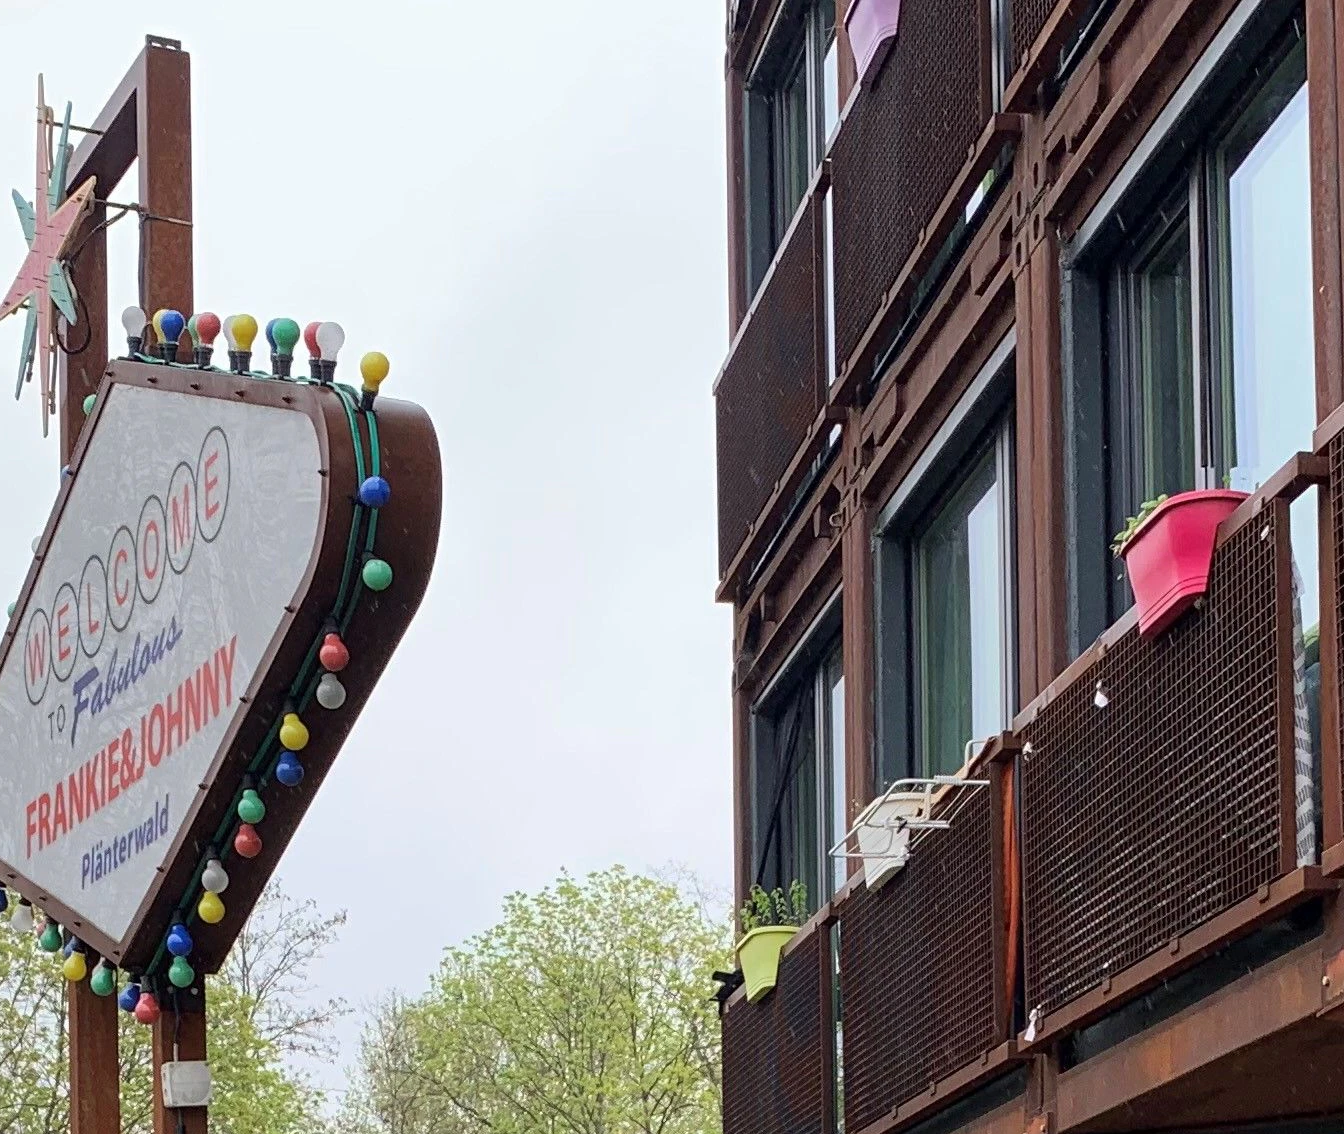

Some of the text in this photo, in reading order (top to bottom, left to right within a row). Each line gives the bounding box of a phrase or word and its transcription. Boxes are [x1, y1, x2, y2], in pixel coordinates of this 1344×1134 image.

[27, 451, 219, 686] WELCOME
[25, 634, 238, 860] FRANKIE&JOHNNY
[47, 616, 184, 748] TO Fabulous
[81, 793, 169, 889] Plänterwald
